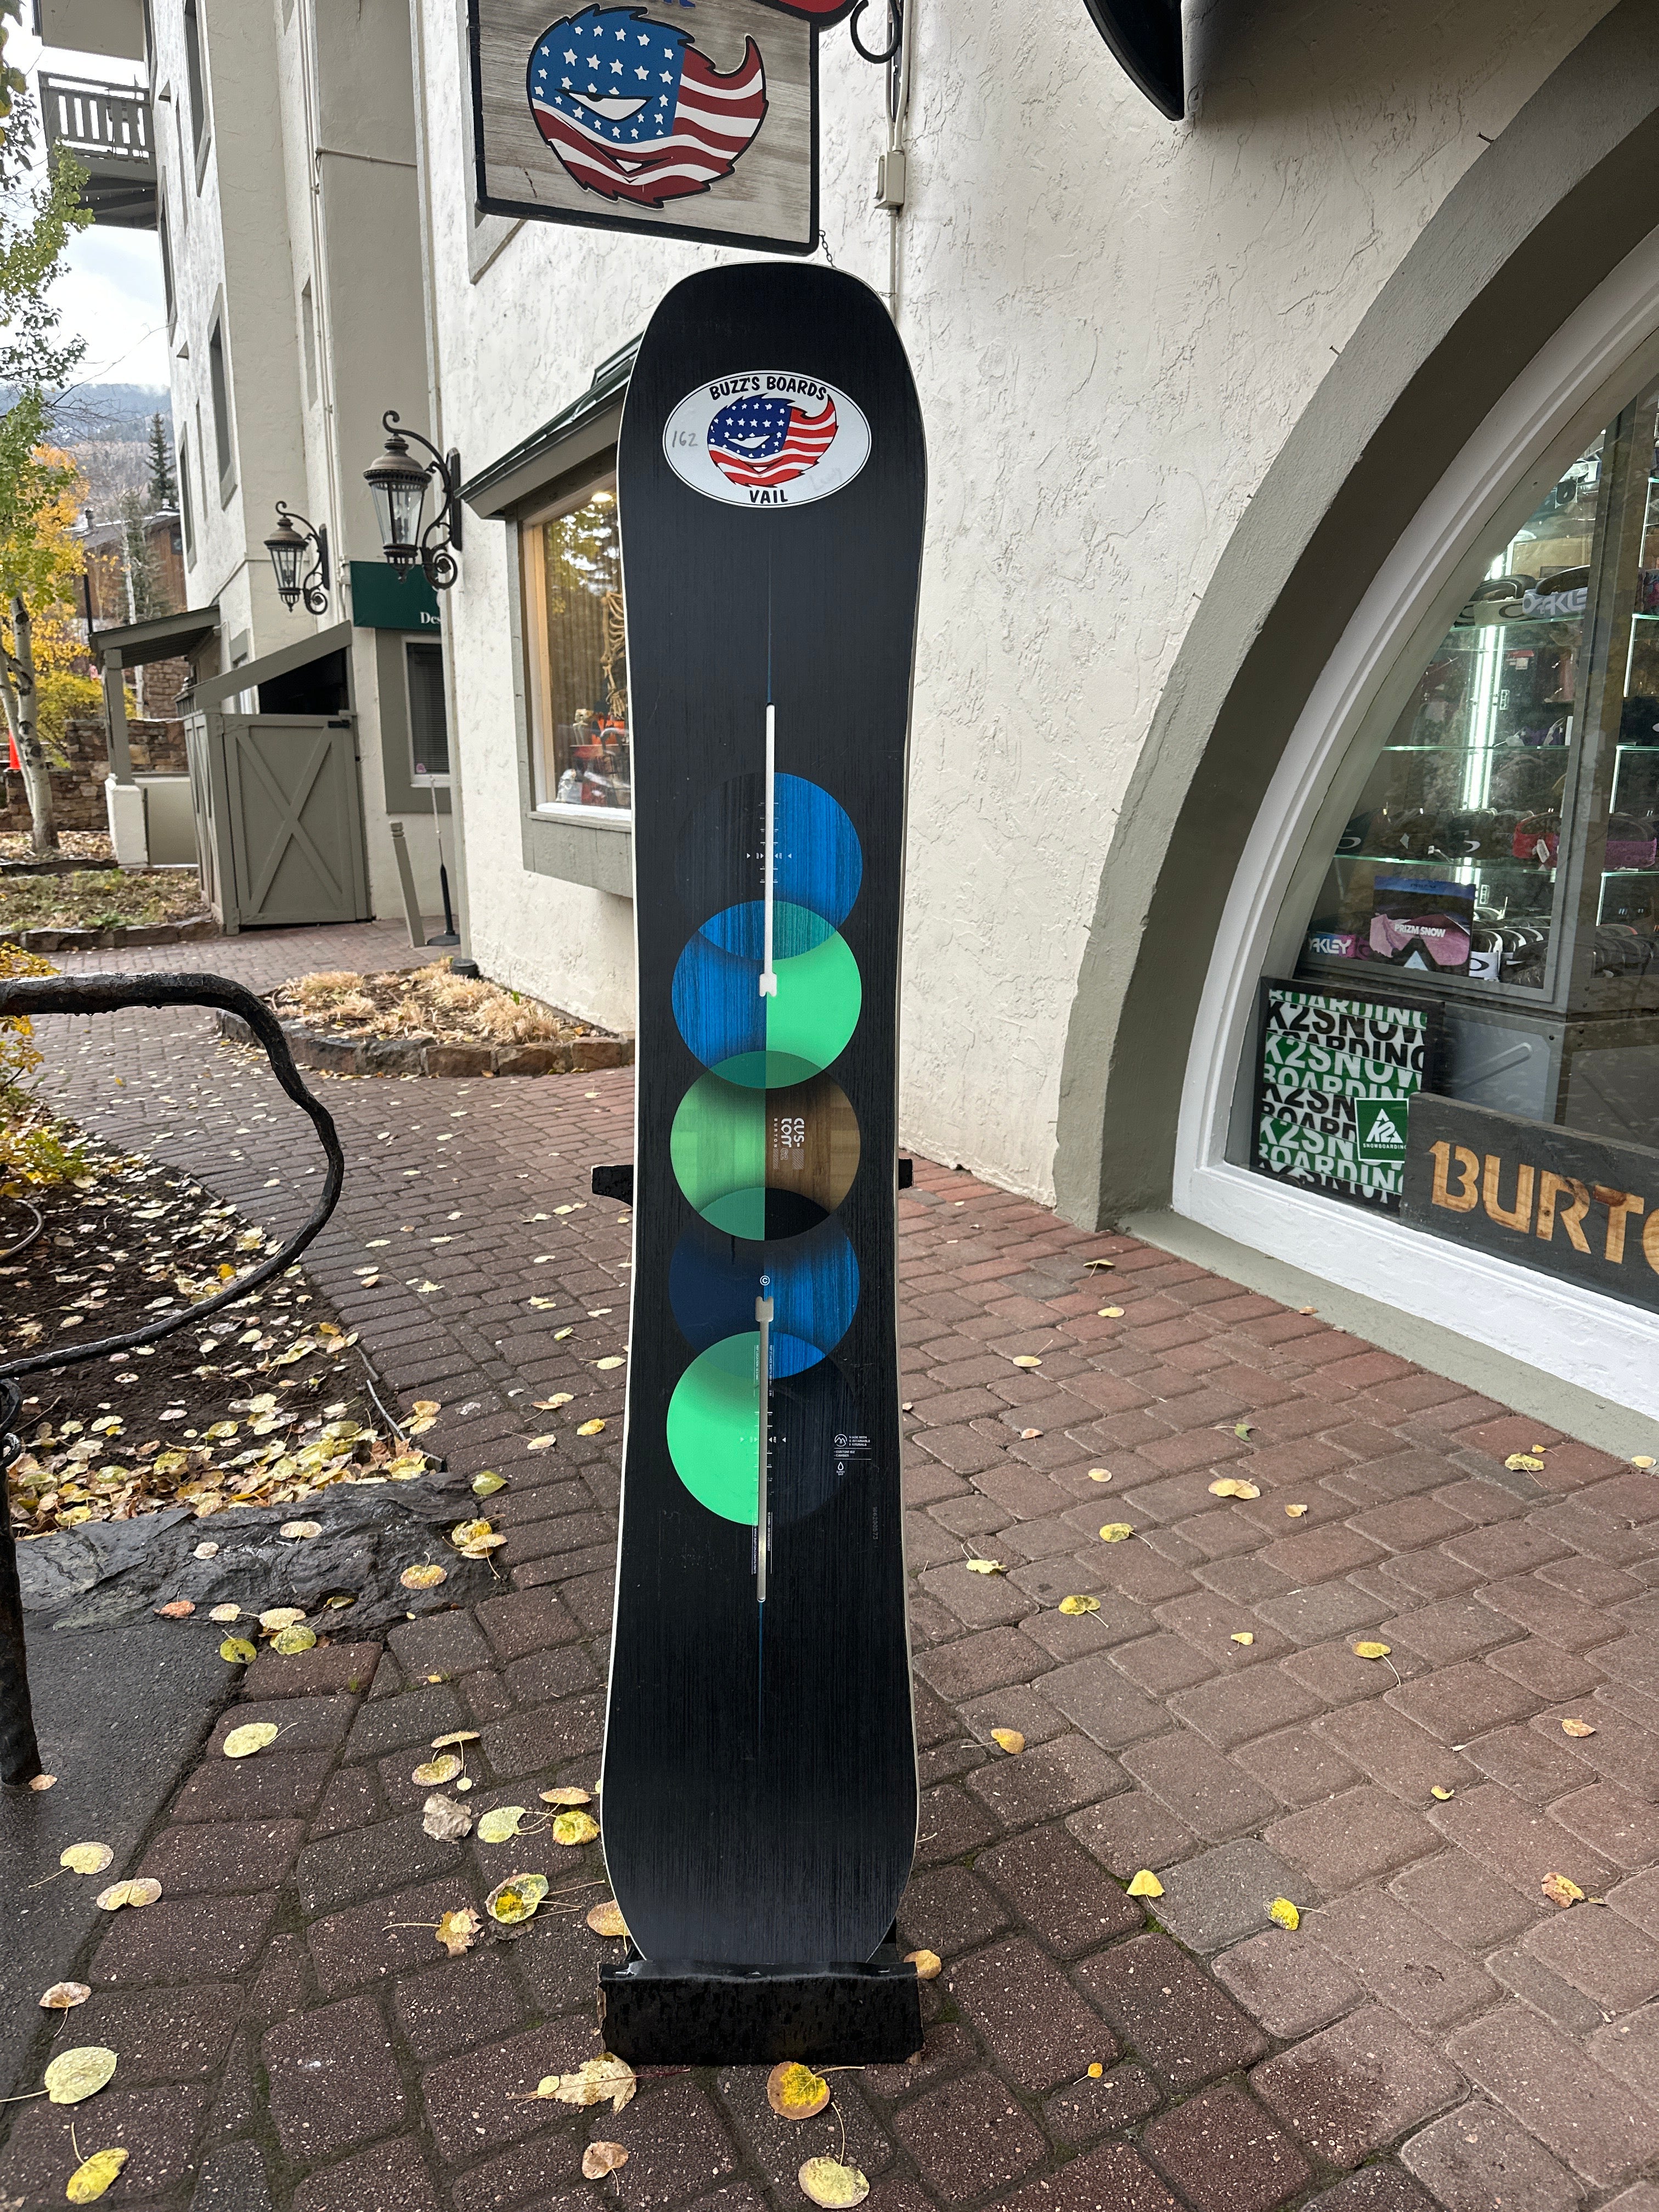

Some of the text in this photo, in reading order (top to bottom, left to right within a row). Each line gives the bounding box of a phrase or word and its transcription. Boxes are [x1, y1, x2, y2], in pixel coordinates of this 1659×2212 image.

[709, 376, 827, 400] BUZZ'S BOARDS
[672, 431, 698, 448] 162
[749, 489, 788, 504] VAIL
[1522, 588, 1588, 615] OAKLE
[1394, 924, 1446, 938] PRIZM SNOW
[1308, 938, 1352, 954] AKLEY
